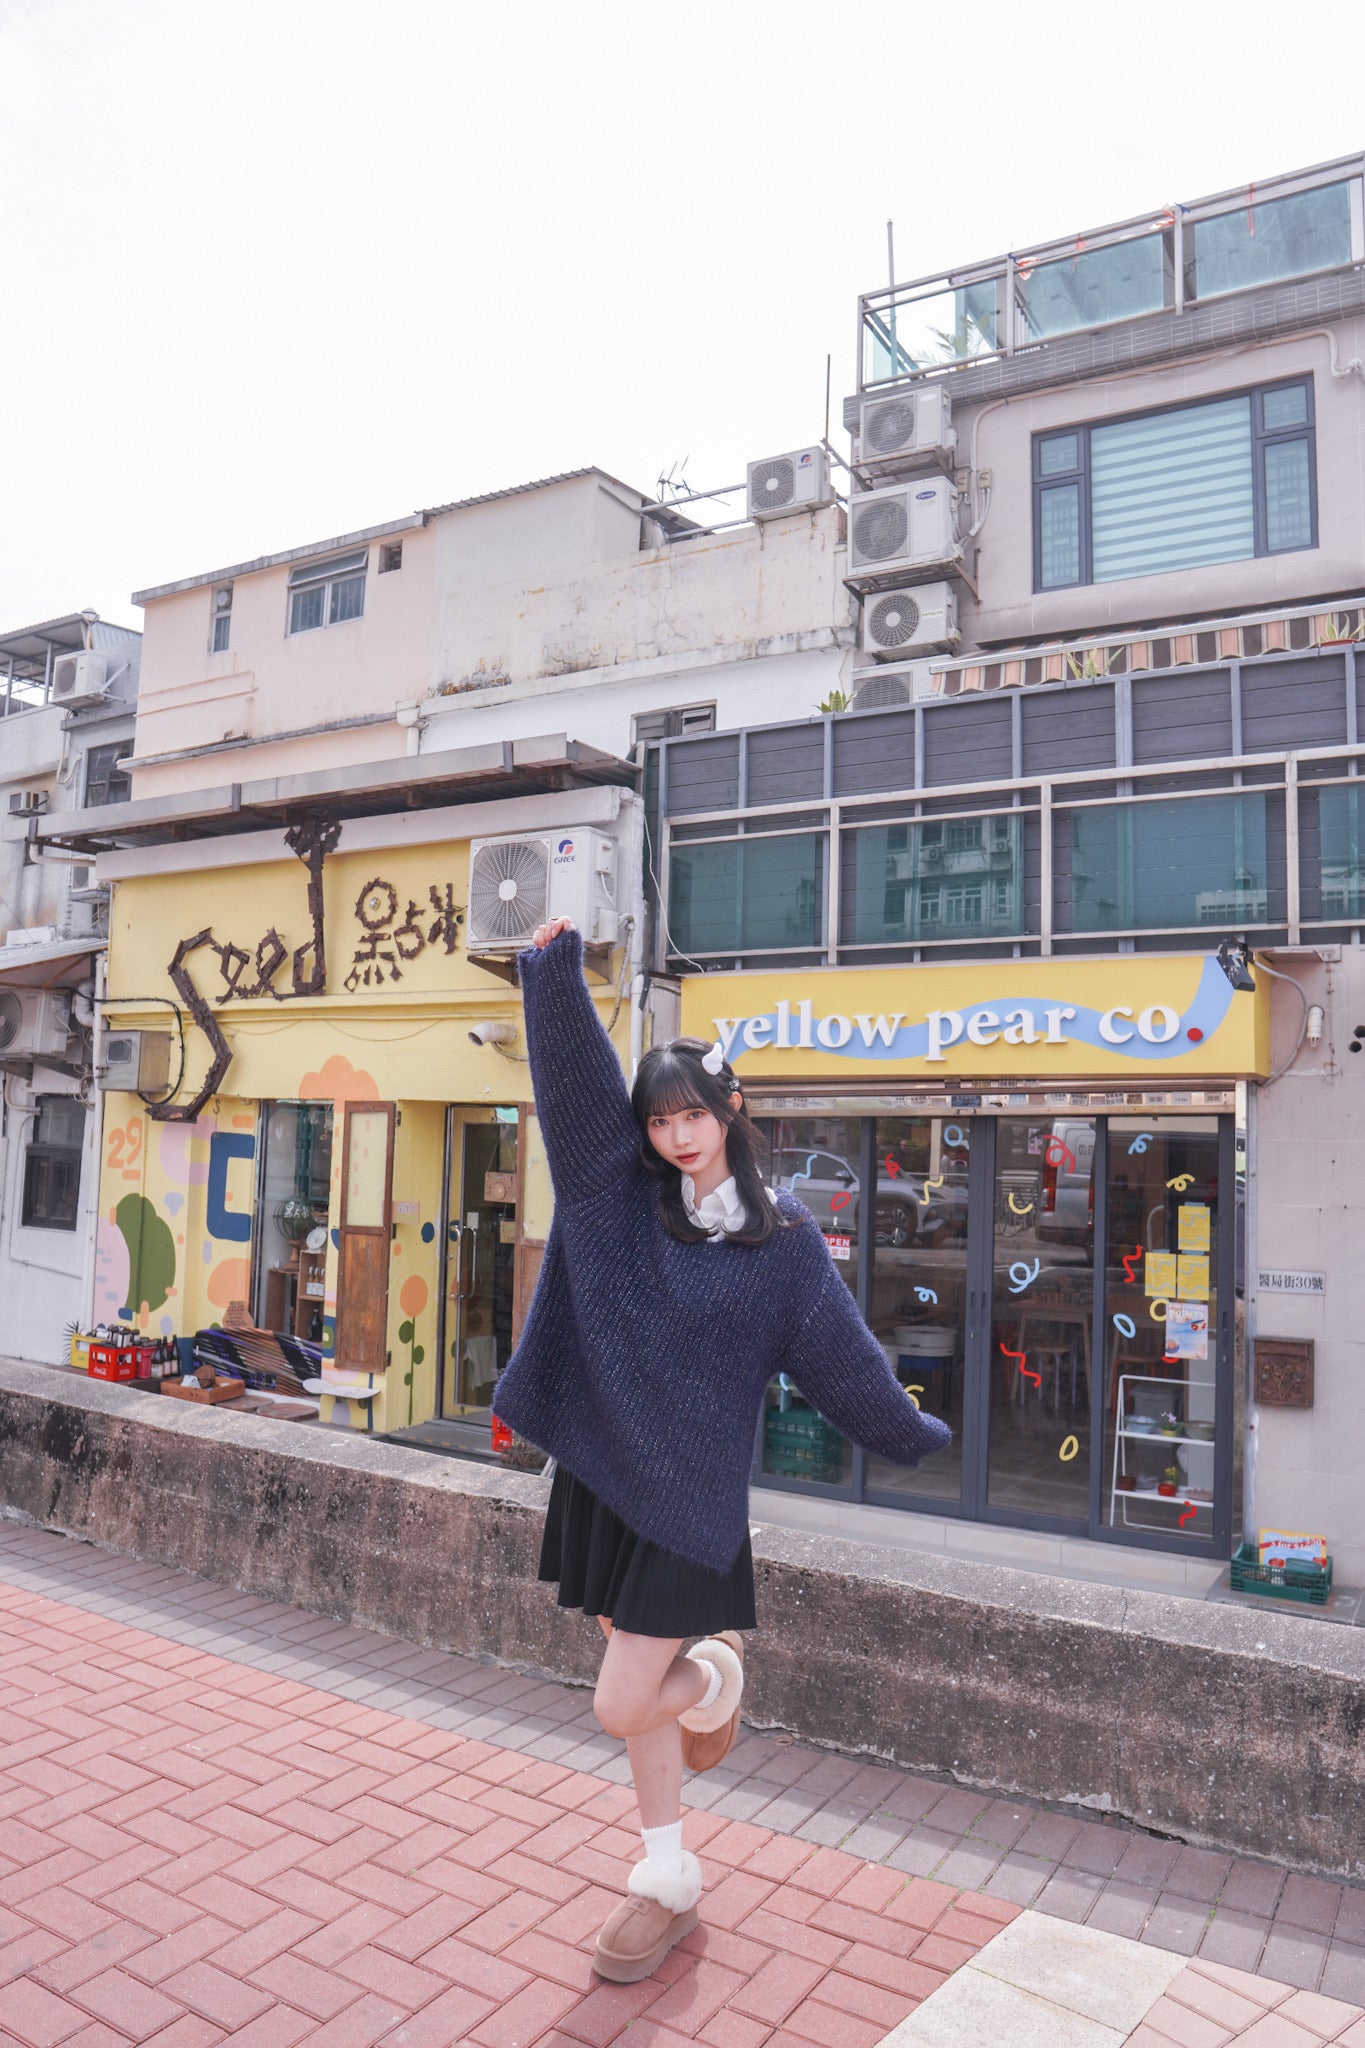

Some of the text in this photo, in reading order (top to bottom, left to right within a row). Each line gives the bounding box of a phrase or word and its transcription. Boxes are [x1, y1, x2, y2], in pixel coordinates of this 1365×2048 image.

[553, 855, 576, 864] GREE
[711, 999, 1204, 1061] yellow pear co.
[107, 1116, 143, 1169] 29
[1259, 1273, 1324, 1290] 醫局街30號
